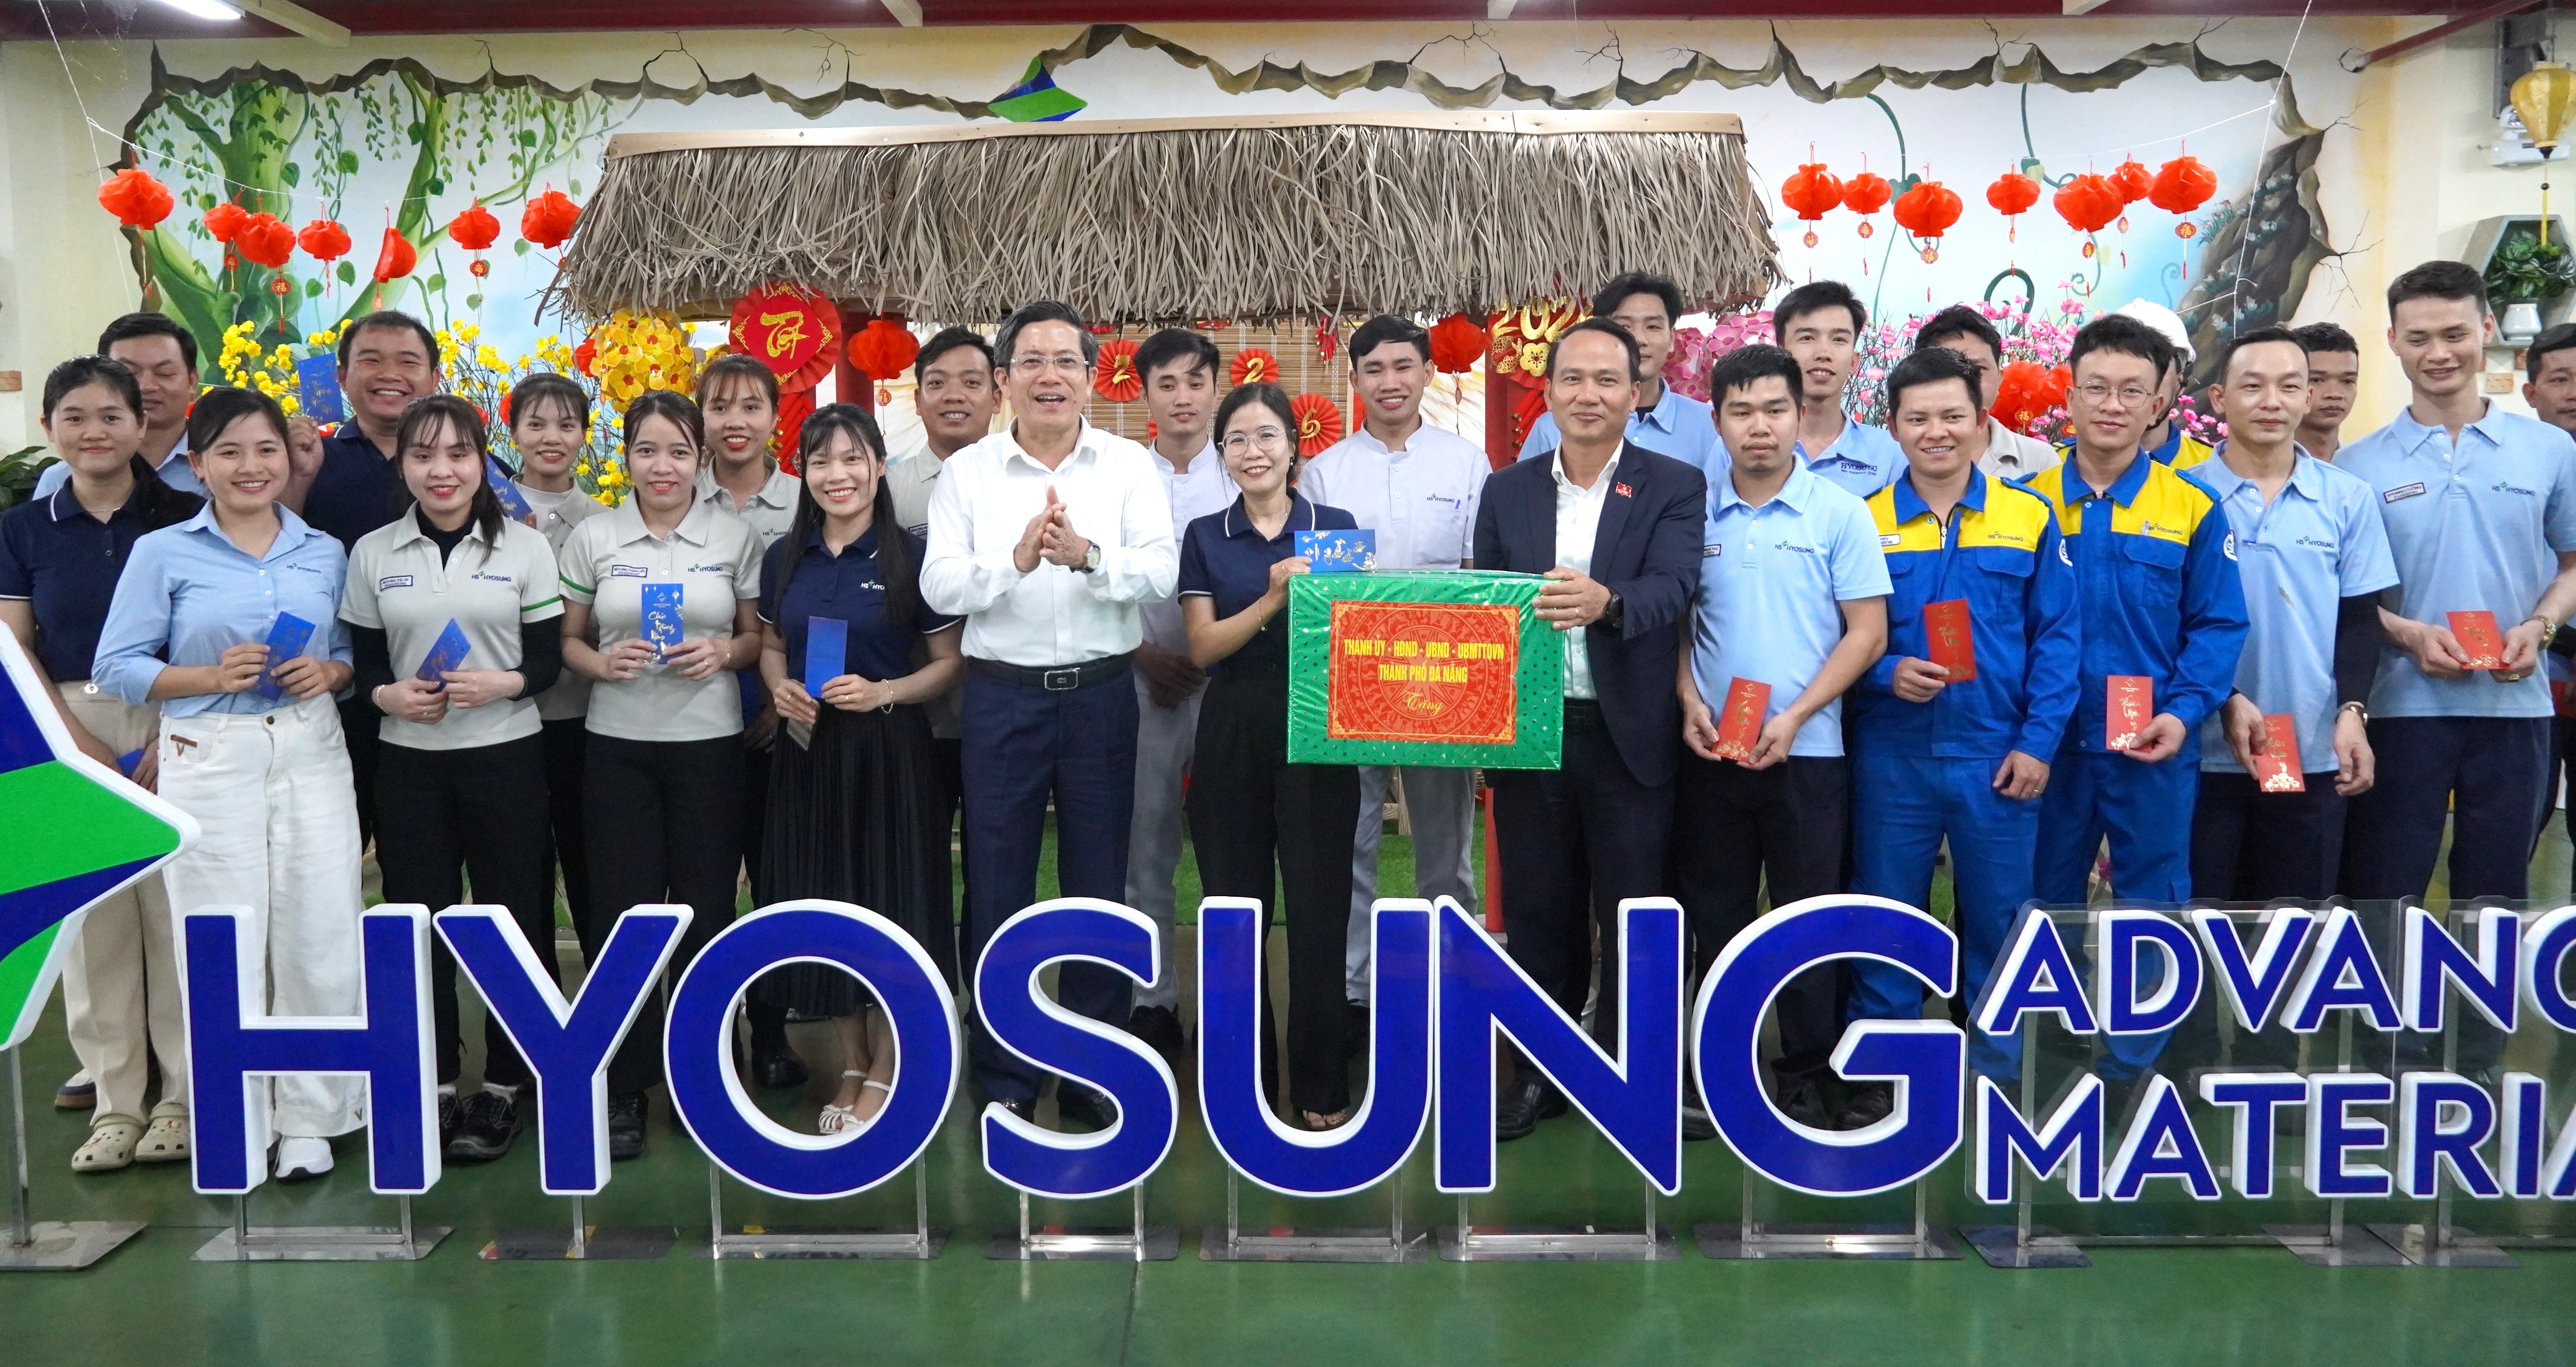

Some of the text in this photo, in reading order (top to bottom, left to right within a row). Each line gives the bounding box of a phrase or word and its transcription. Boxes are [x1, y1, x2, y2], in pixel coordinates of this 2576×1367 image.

[1243, 357, 1264, 384] 2
[1300, 407, 1320, 438] 6
[1841, 462, 1878, 472] HYOSUNG
[2157, 526, 2183, 535] HYOSUNG
[1787, 545, 1815, 554] HYOSUNG
[2309, 540, 2335, 549] HYOSUNG
[484, 574, 512, 582] HYOSUNG
[1344, 636, 1372, 655] THÀNH
[1374, 635, 1386, 656] ỦY
[1393, 640, 1418, 657] HĐND
[1426, 642, 1449, 658] UBND
[1458, 642, 1504, 660] UBMTTQVN
[1378, 660, 1468, 683] THÀNH PHỐ ĐÀ NẴNG
[1403, 690, 1443, 716] Tặng
[185, 894, 1967, 1200] HYOSUNG
[1975, 1071, 2576, 1204] MATERI
